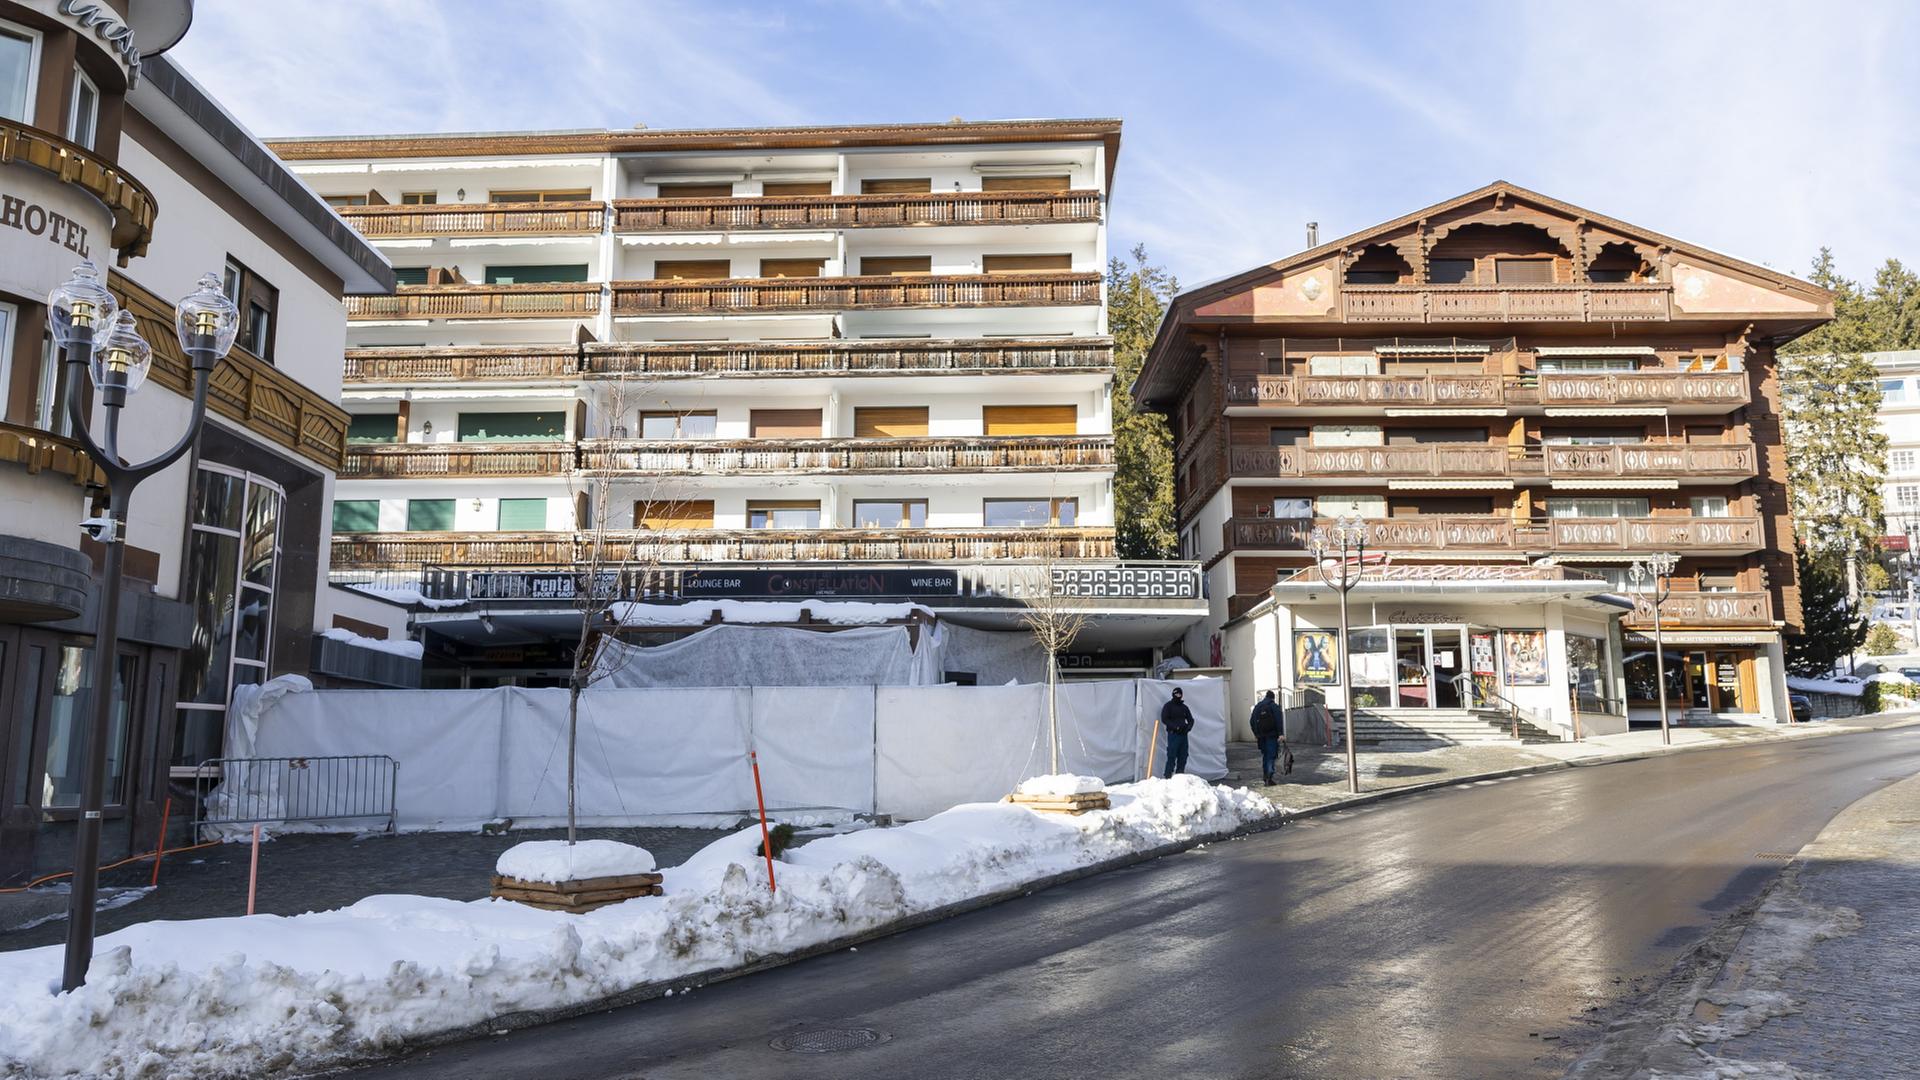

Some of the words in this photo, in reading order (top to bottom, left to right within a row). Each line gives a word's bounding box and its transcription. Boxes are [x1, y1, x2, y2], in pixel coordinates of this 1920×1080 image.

[0, 194, 89, 259] HOTEL
[533, 576, 575, 592] rental
[688, 578, 722, 589] LOUNGE
[723, 579, 741, 588] BAR
[911, 578, 933, 587] WINE
[934, 577, 952, 587] BAR
